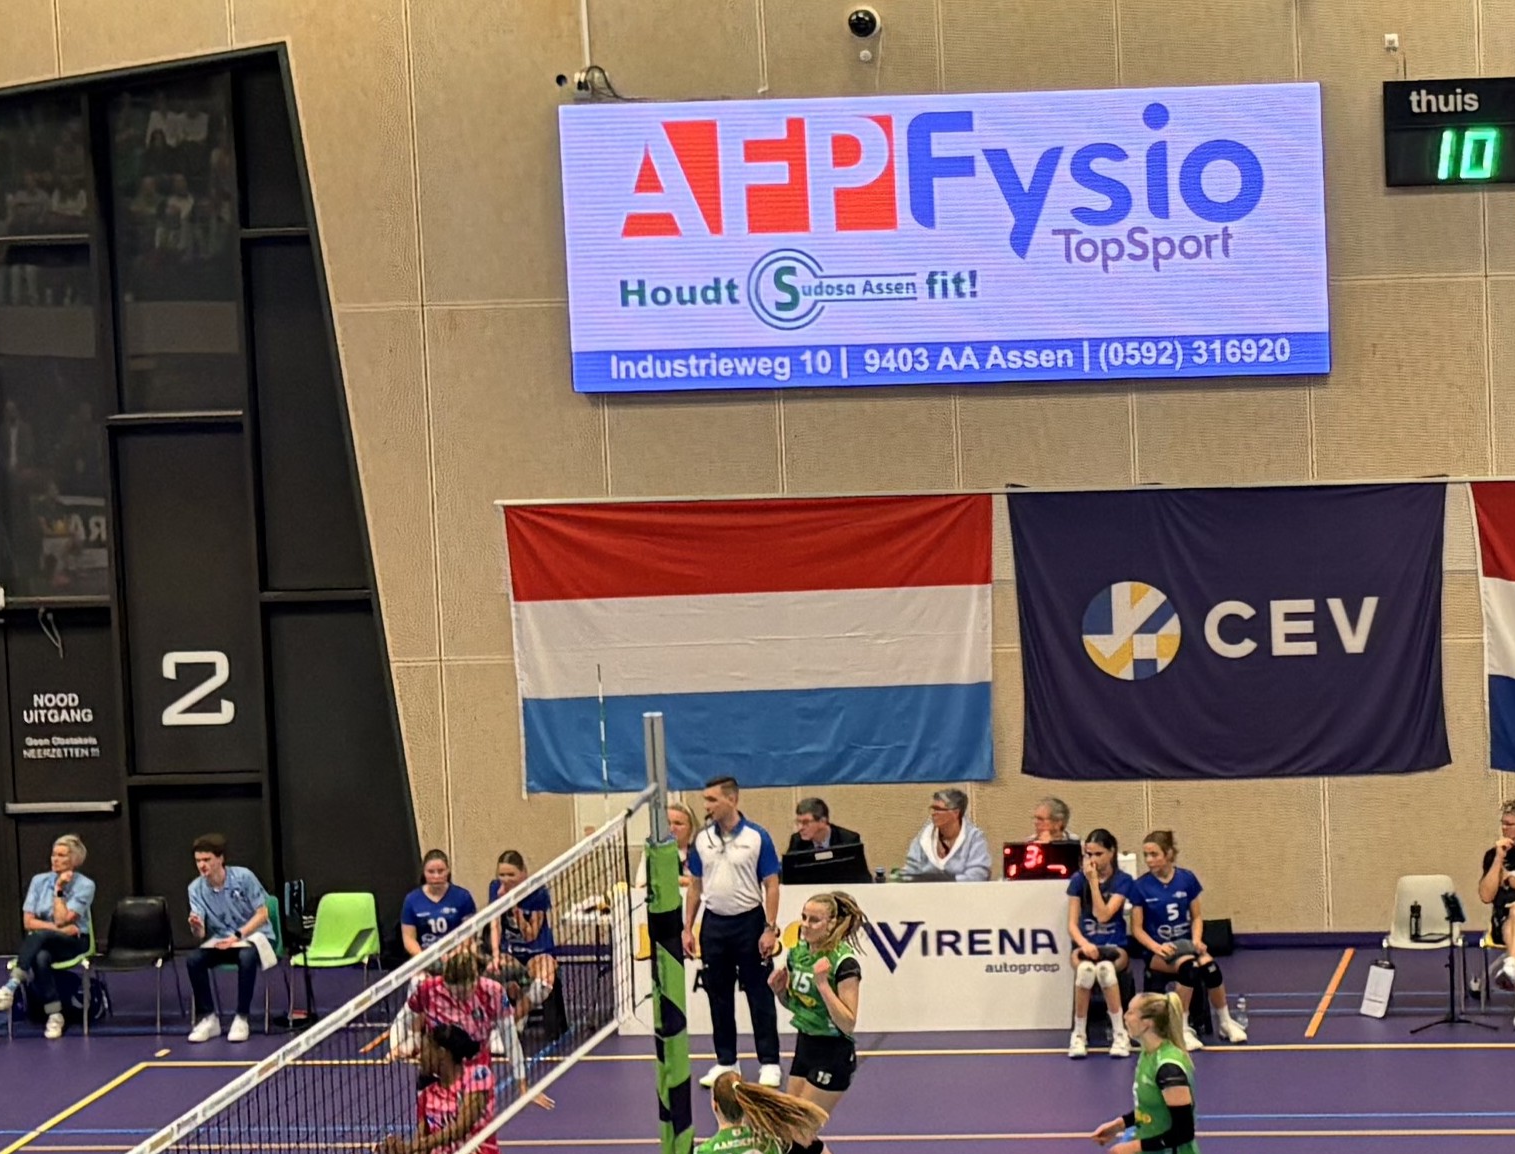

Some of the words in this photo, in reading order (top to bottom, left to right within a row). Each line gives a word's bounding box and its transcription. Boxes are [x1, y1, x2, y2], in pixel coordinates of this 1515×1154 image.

[1409, 88, 1480, 113] thuis
[1437, 128, 1497, 180] 10
[1051, 226, 1234, 274] TopSport
[619, 276, 741, 308] Houdt
[862, 278, 917, 296] Assen
[926, 269, 978, 300] fit!
[610, 352, 792, 382] Industrieweg
[799, 349, 832, 374] 10
[863, 346, 930, 372] 9403
[936, 345, 980, 371] AA
[985, 345, 1074, 370] Assen
[1099, 340, 1184, 373] (0592)
[1191, 337, 1291, 365] 316920
[1204, 596, 1379, 658] CEV
[33, 693, 79, 707] NOOD
[162, 651, 235, 726] 2
[23, 708, 94, 724] UITGANG
[428, 917, 448, 934] 10
[1166, 903, 1179, 921] 5
[862, 921, 1059, 974] VIRENA
[985, 962, 1061, 975] autogroep
[816, 1070, 833, 1085] 15
